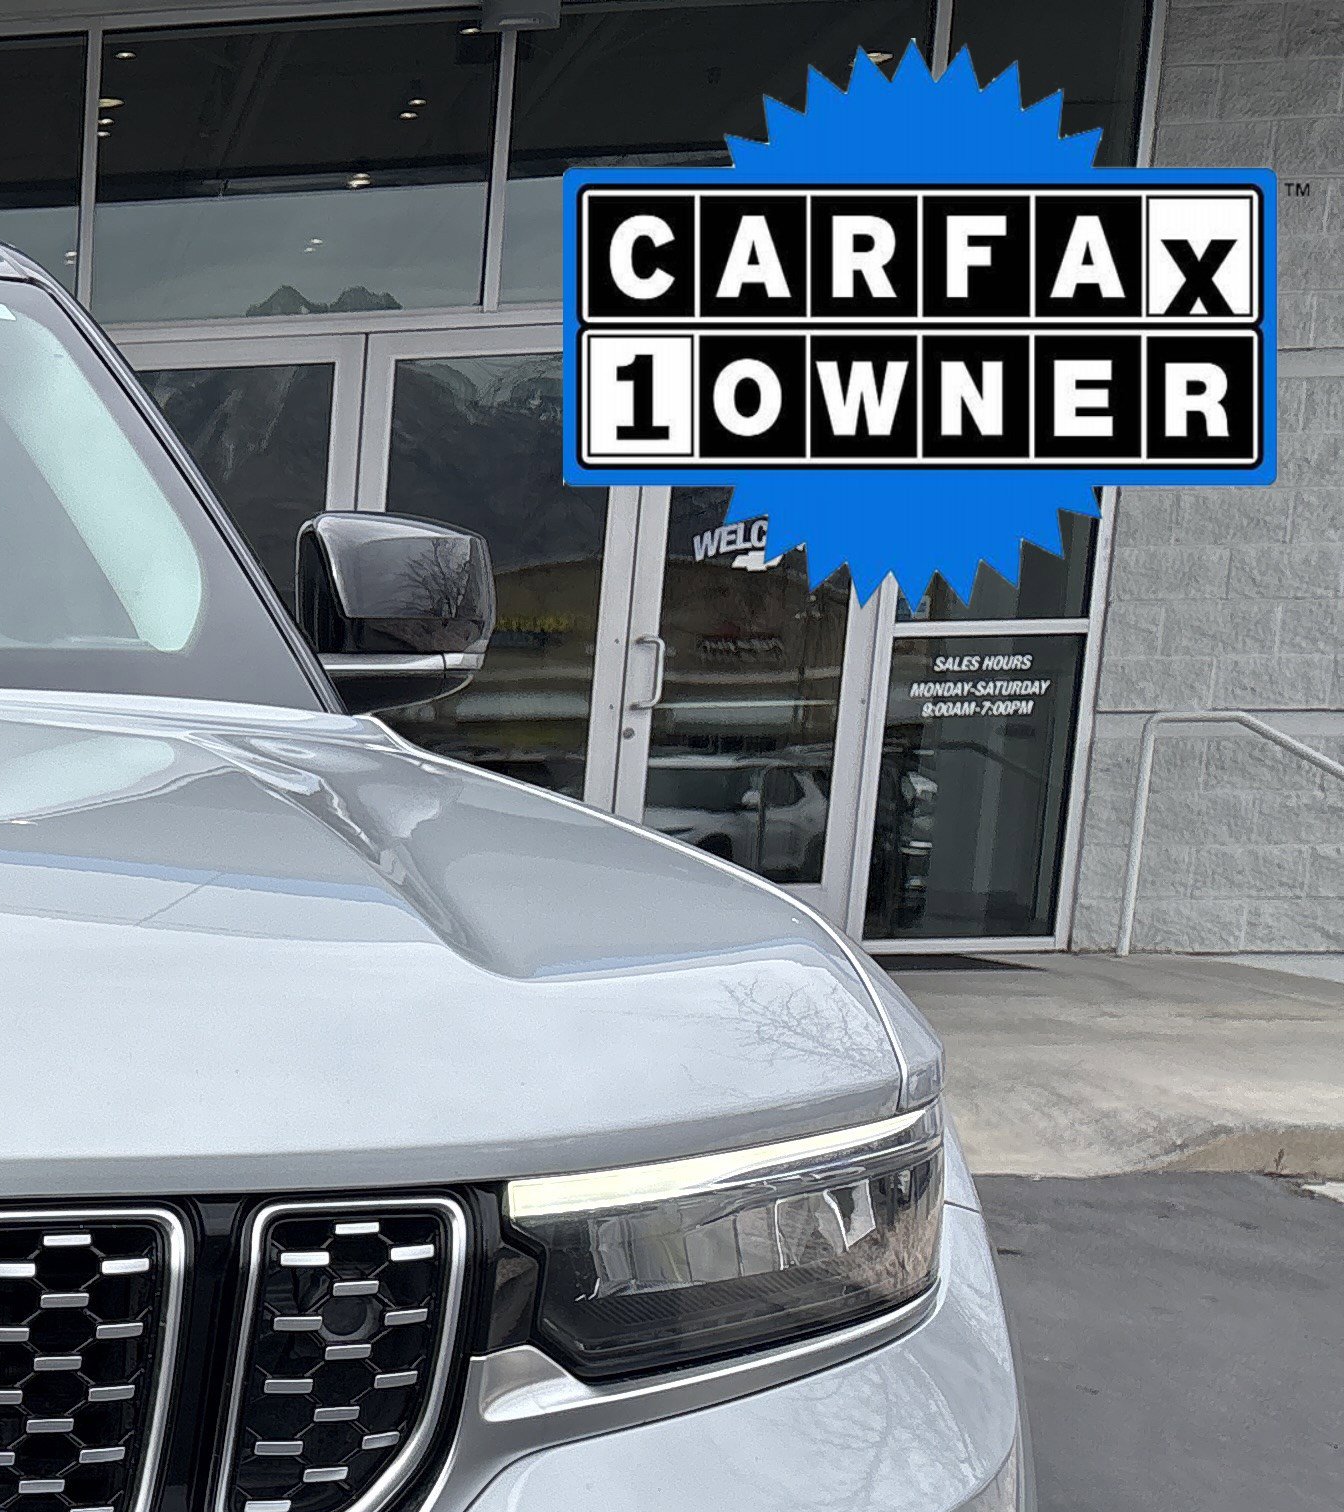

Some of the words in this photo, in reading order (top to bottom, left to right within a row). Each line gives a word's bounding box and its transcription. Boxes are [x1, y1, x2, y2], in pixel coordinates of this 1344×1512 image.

[693, 520, 769, 562] WELC
[934, 656, 981, 672] SALES
[982, 655, 1033, 670] HOURS
[910, 680, 1051, 697] MONDAY-SATURDAY
